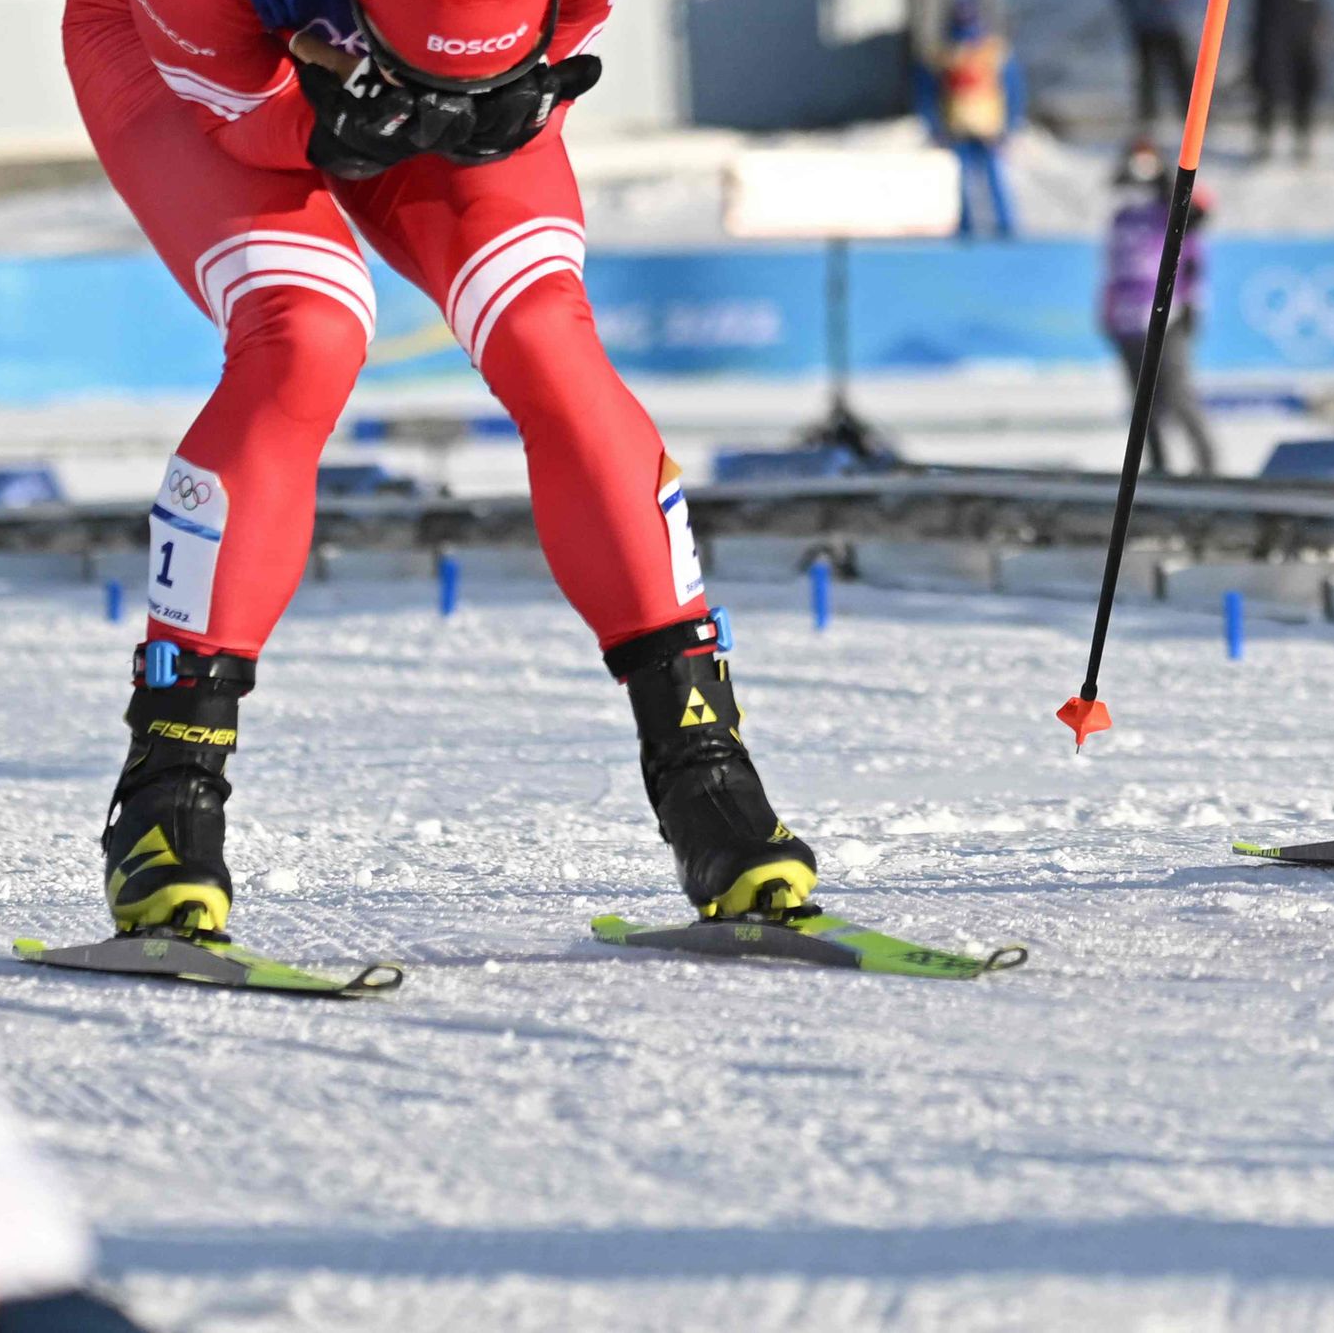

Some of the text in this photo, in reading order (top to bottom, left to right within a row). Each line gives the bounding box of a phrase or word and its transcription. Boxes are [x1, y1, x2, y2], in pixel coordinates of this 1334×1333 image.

[426, 32, 517, 55] BOSCO
[156, 541, 174, 589] 1
[148, 719, 237, 746] FISCHER
